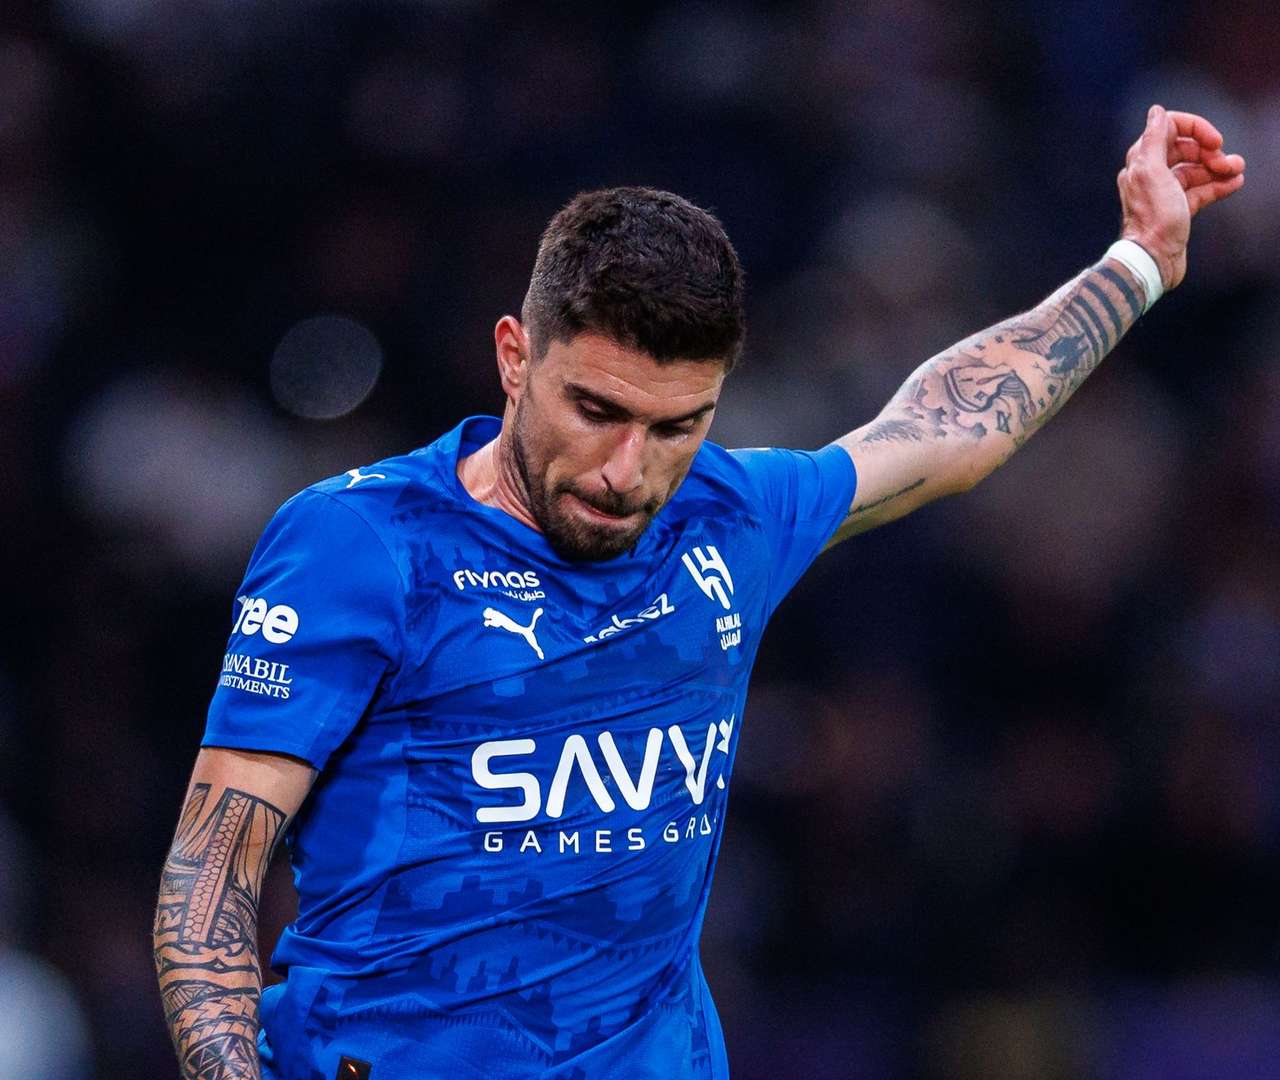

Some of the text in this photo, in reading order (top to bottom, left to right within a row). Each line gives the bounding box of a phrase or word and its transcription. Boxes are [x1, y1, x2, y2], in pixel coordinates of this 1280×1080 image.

[453, 569, 540, 590] flynas
[231, 595, 299, 644] ree
[223, 653, 293, 685] ANABIL
[483, 809, 719, 853] GAMES GRO
